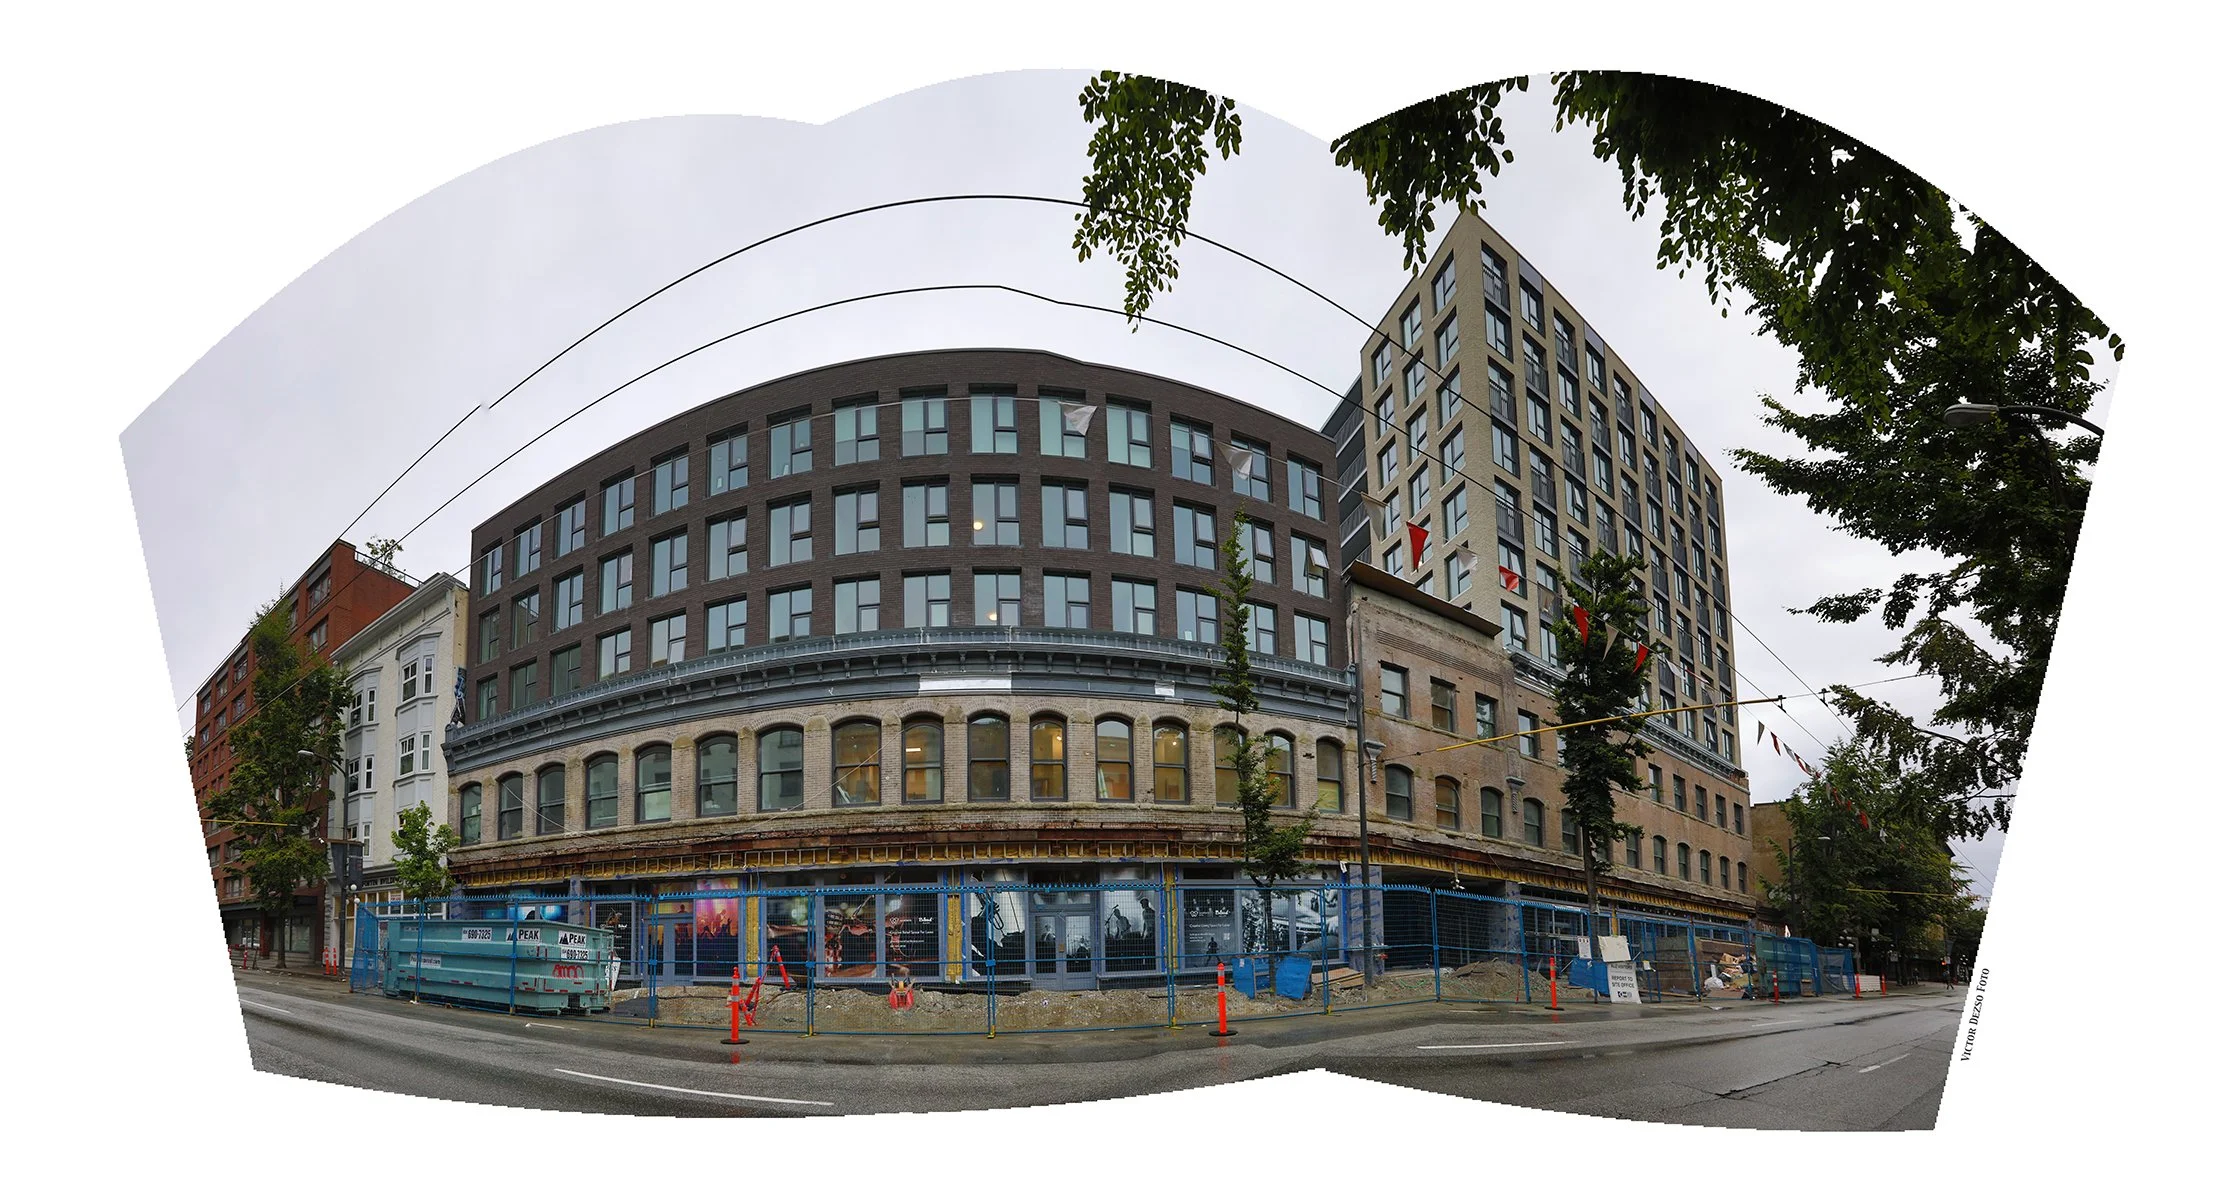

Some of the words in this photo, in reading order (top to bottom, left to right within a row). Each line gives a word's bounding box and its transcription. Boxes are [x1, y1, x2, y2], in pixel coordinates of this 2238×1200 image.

[467, 929, 491, 940] 690-7325
[518, 929, 539, 940] PEAK
[569, 933, 586, 945] PEAK
